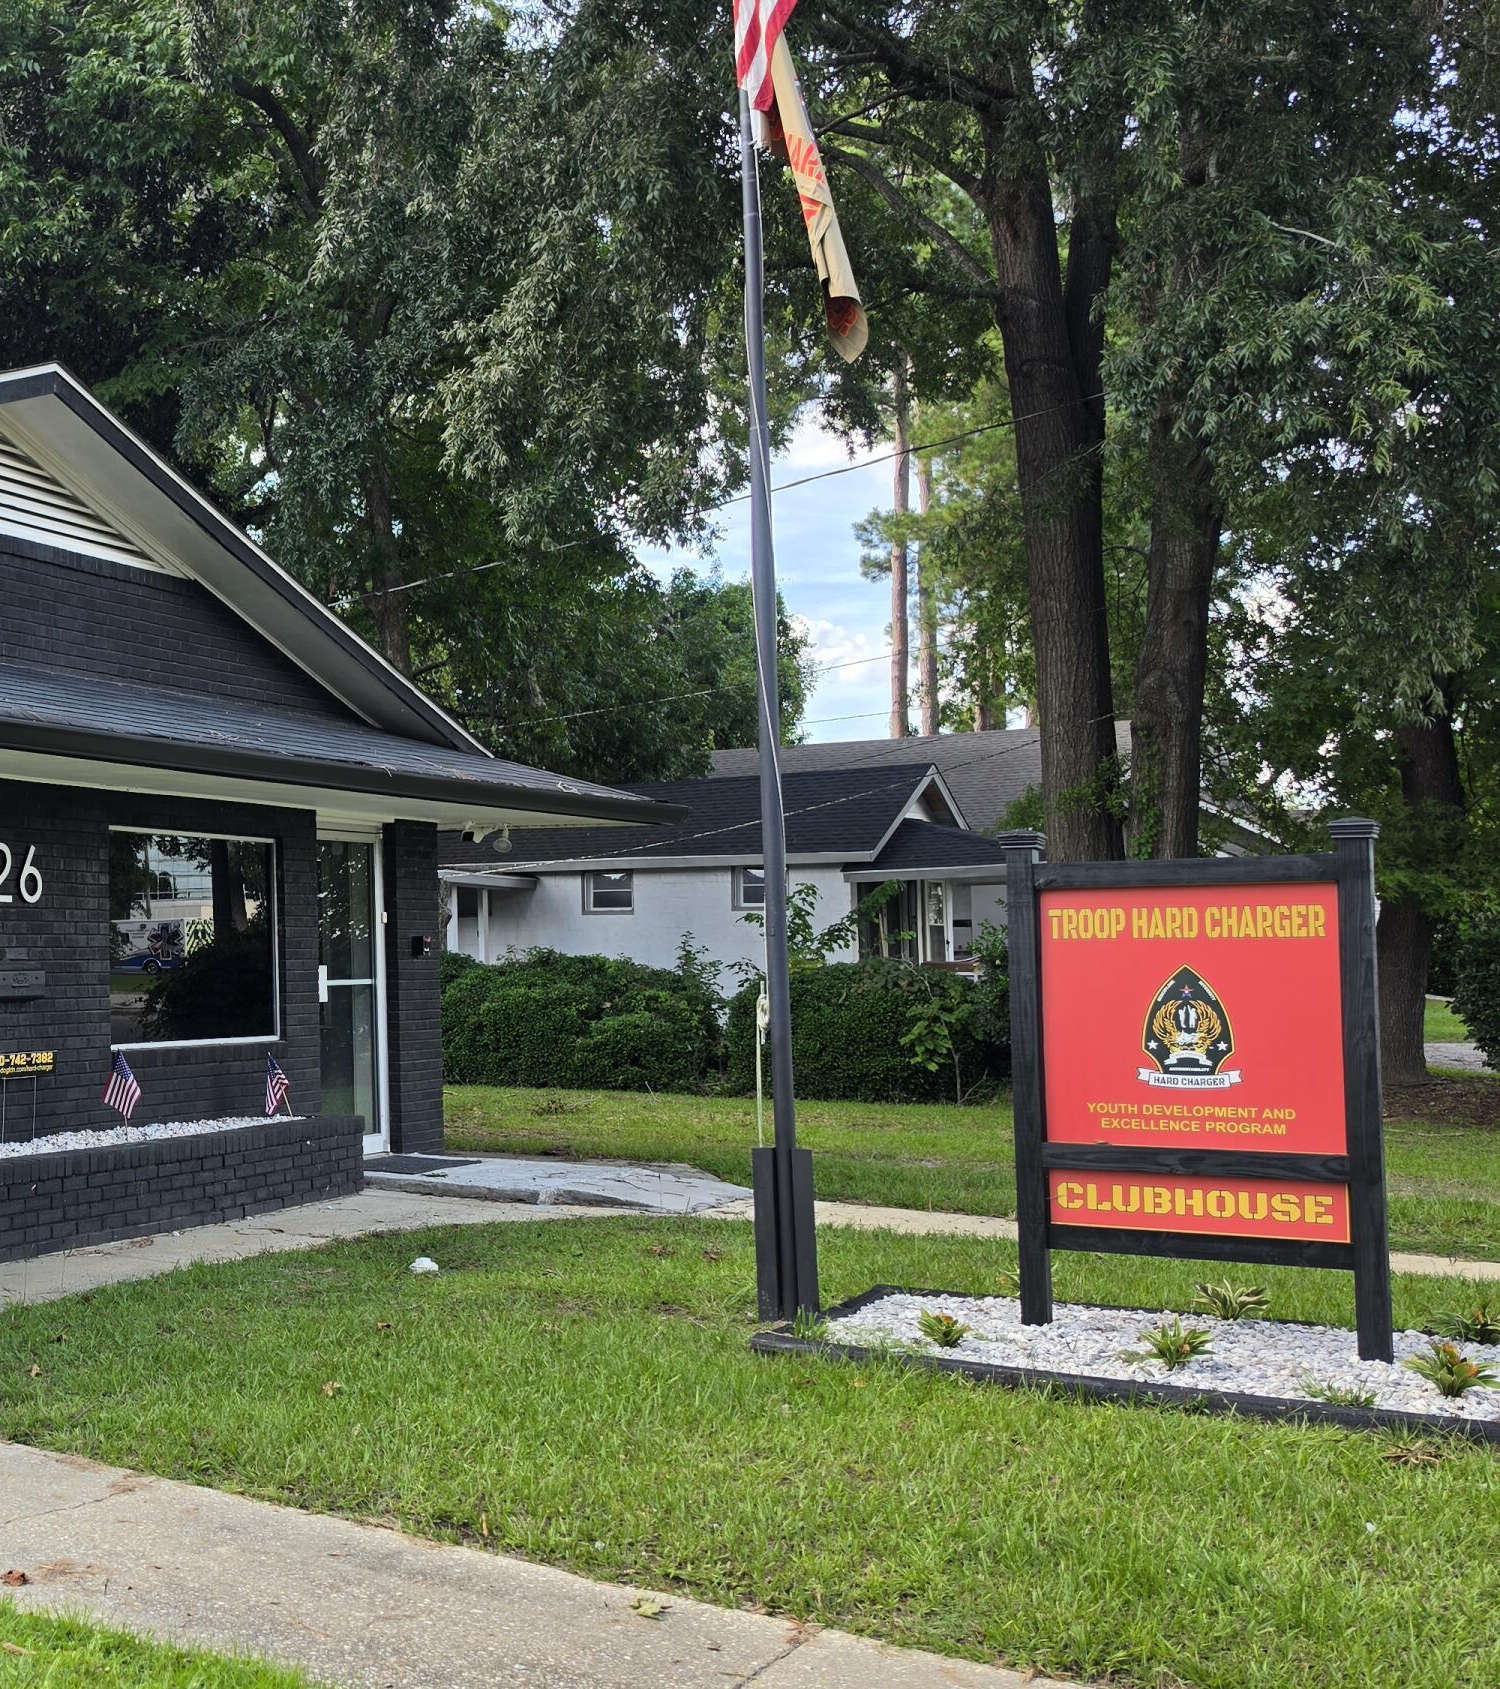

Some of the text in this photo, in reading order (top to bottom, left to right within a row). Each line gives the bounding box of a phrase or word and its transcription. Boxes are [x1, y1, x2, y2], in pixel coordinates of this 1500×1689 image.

[1047, 904, 1327, 940] TROOP HARD CHARGER
[1153, 1075, 1226, 1088] HARD CHARGER
[1086, 1102, 1297, 1121] YOUTH DEVELOPMENT AND
[1100, 1118, 1287, 1136] EXCELLENCE PROGRAM
[1056, 1181, 1335, 1225] CLUBHOUSE
